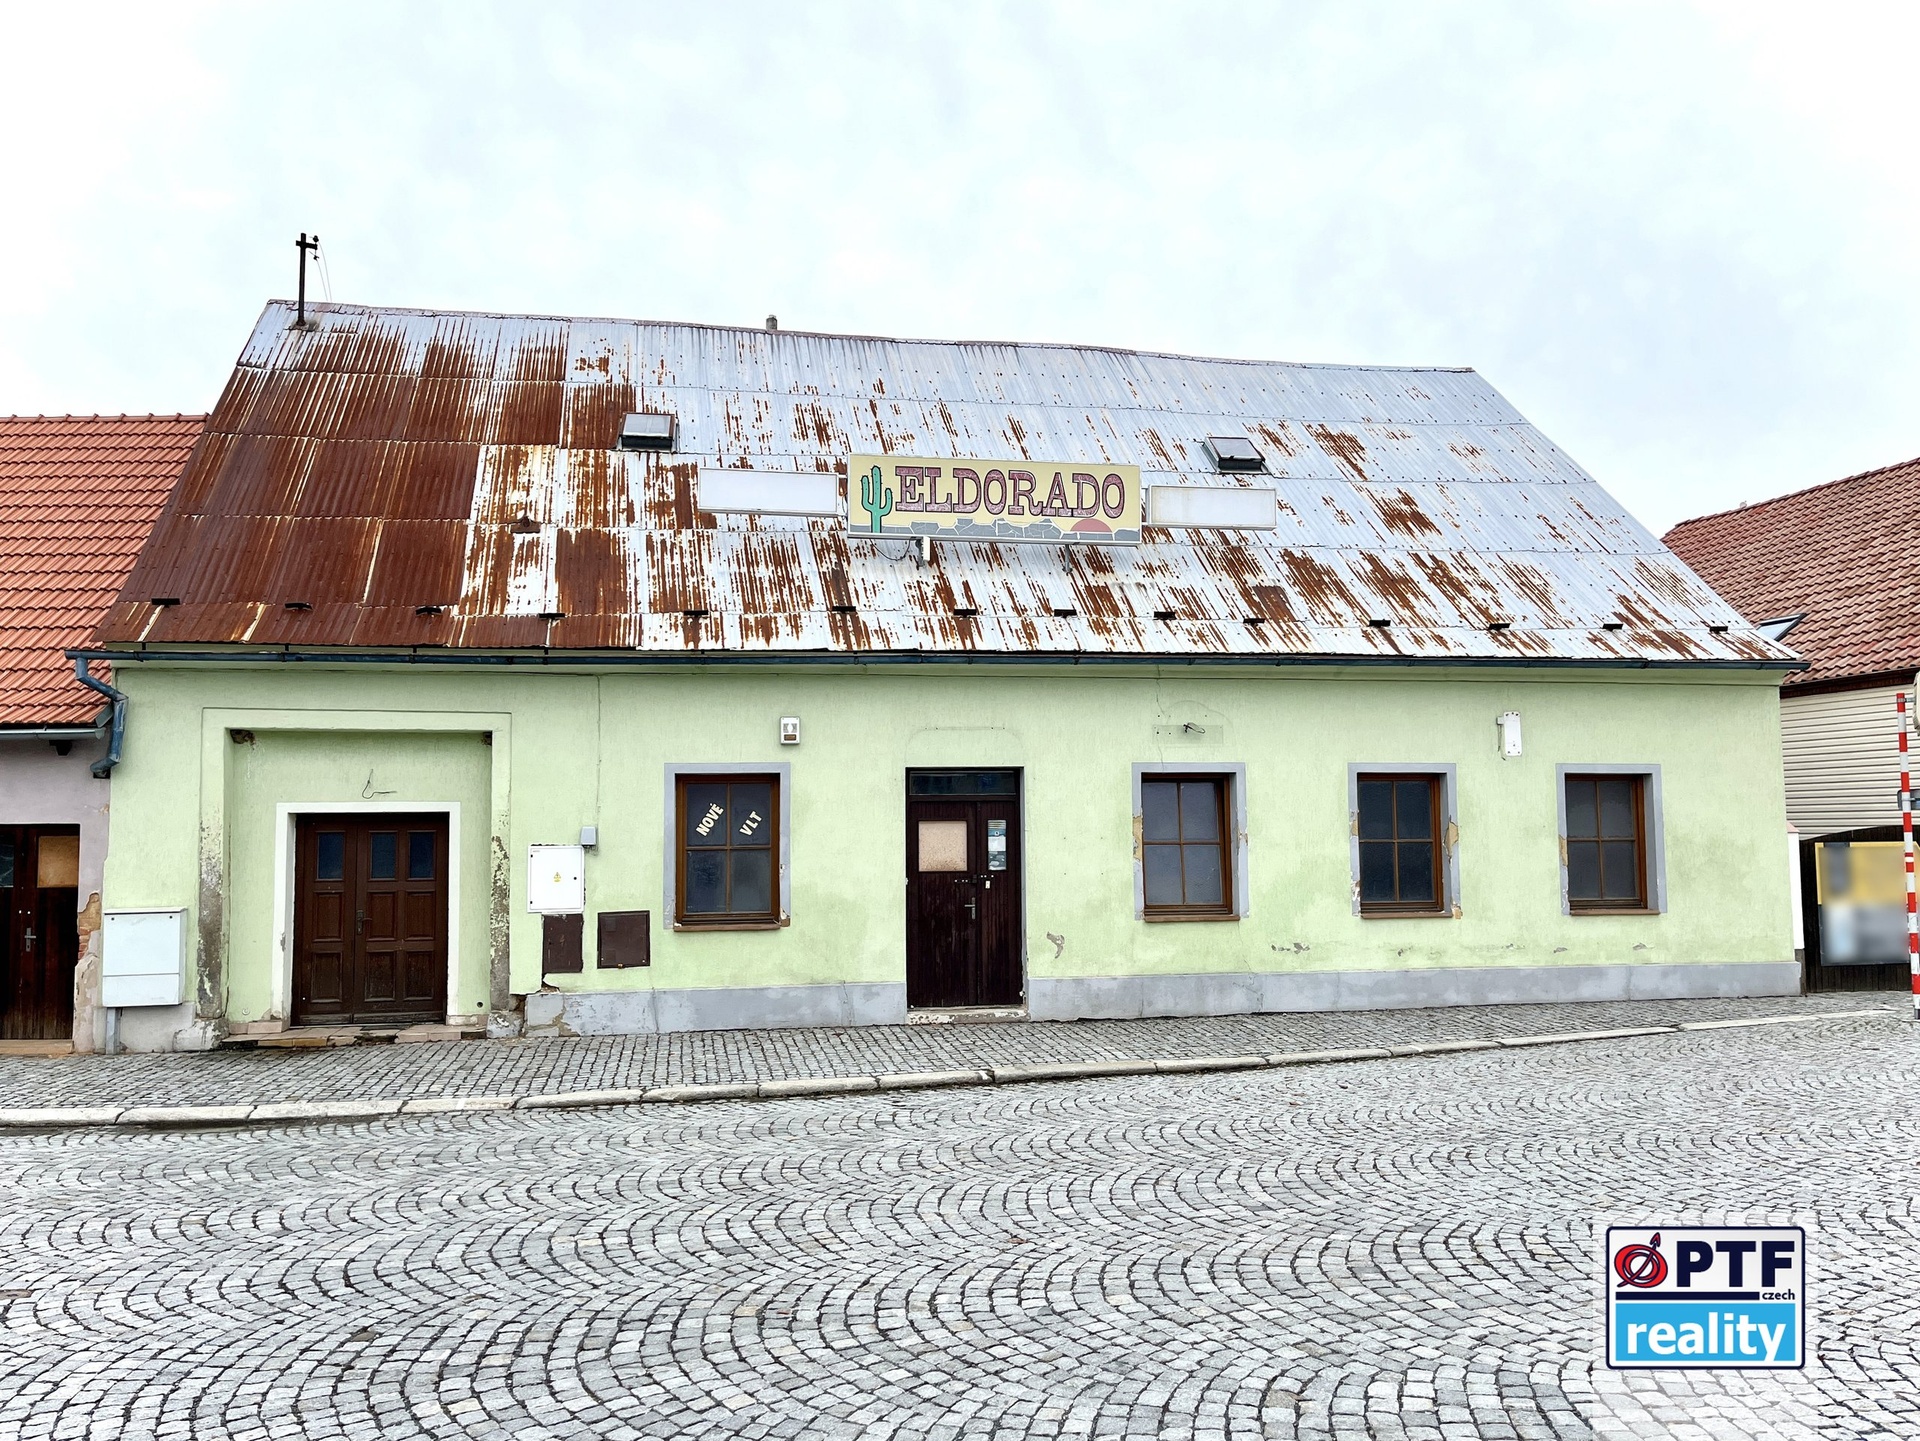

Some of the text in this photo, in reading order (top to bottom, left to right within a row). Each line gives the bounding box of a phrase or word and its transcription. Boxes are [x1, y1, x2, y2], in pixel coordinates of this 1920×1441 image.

[895, 465, 1125, 518] ELDORADO
[695, 802, 763, 837] NOVÉ VLT
